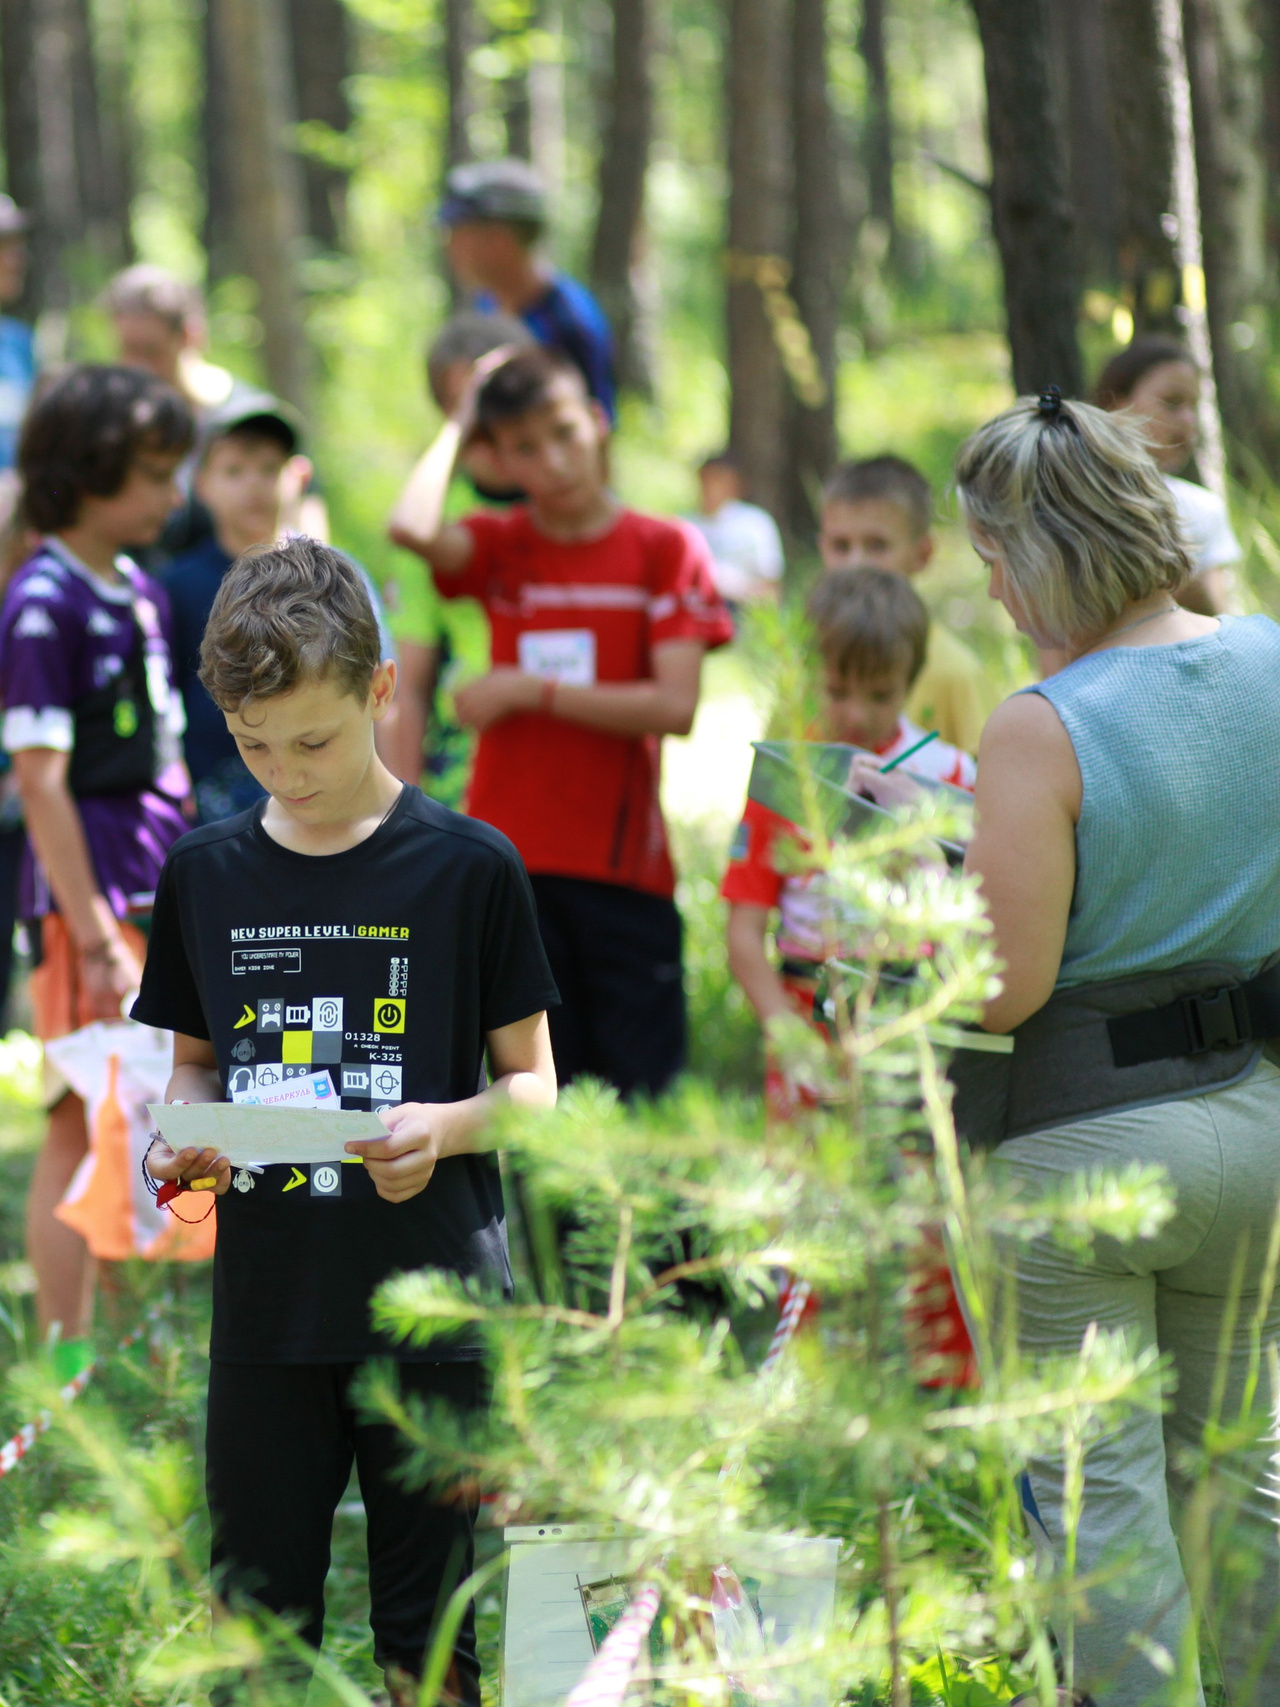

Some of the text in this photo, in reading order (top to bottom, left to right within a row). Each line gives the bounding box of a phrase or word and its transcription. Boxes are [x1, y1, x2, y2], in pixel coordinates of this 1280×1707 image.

[231, 925, 410, 940] NEW SUPER LEVEL GAMER
[344, 1032, 381, 1042] 01328
[369, 1052, 403, 1062] K-325
[263, 1088, 311, 1105] ЧЕБАРКУЛЬ
